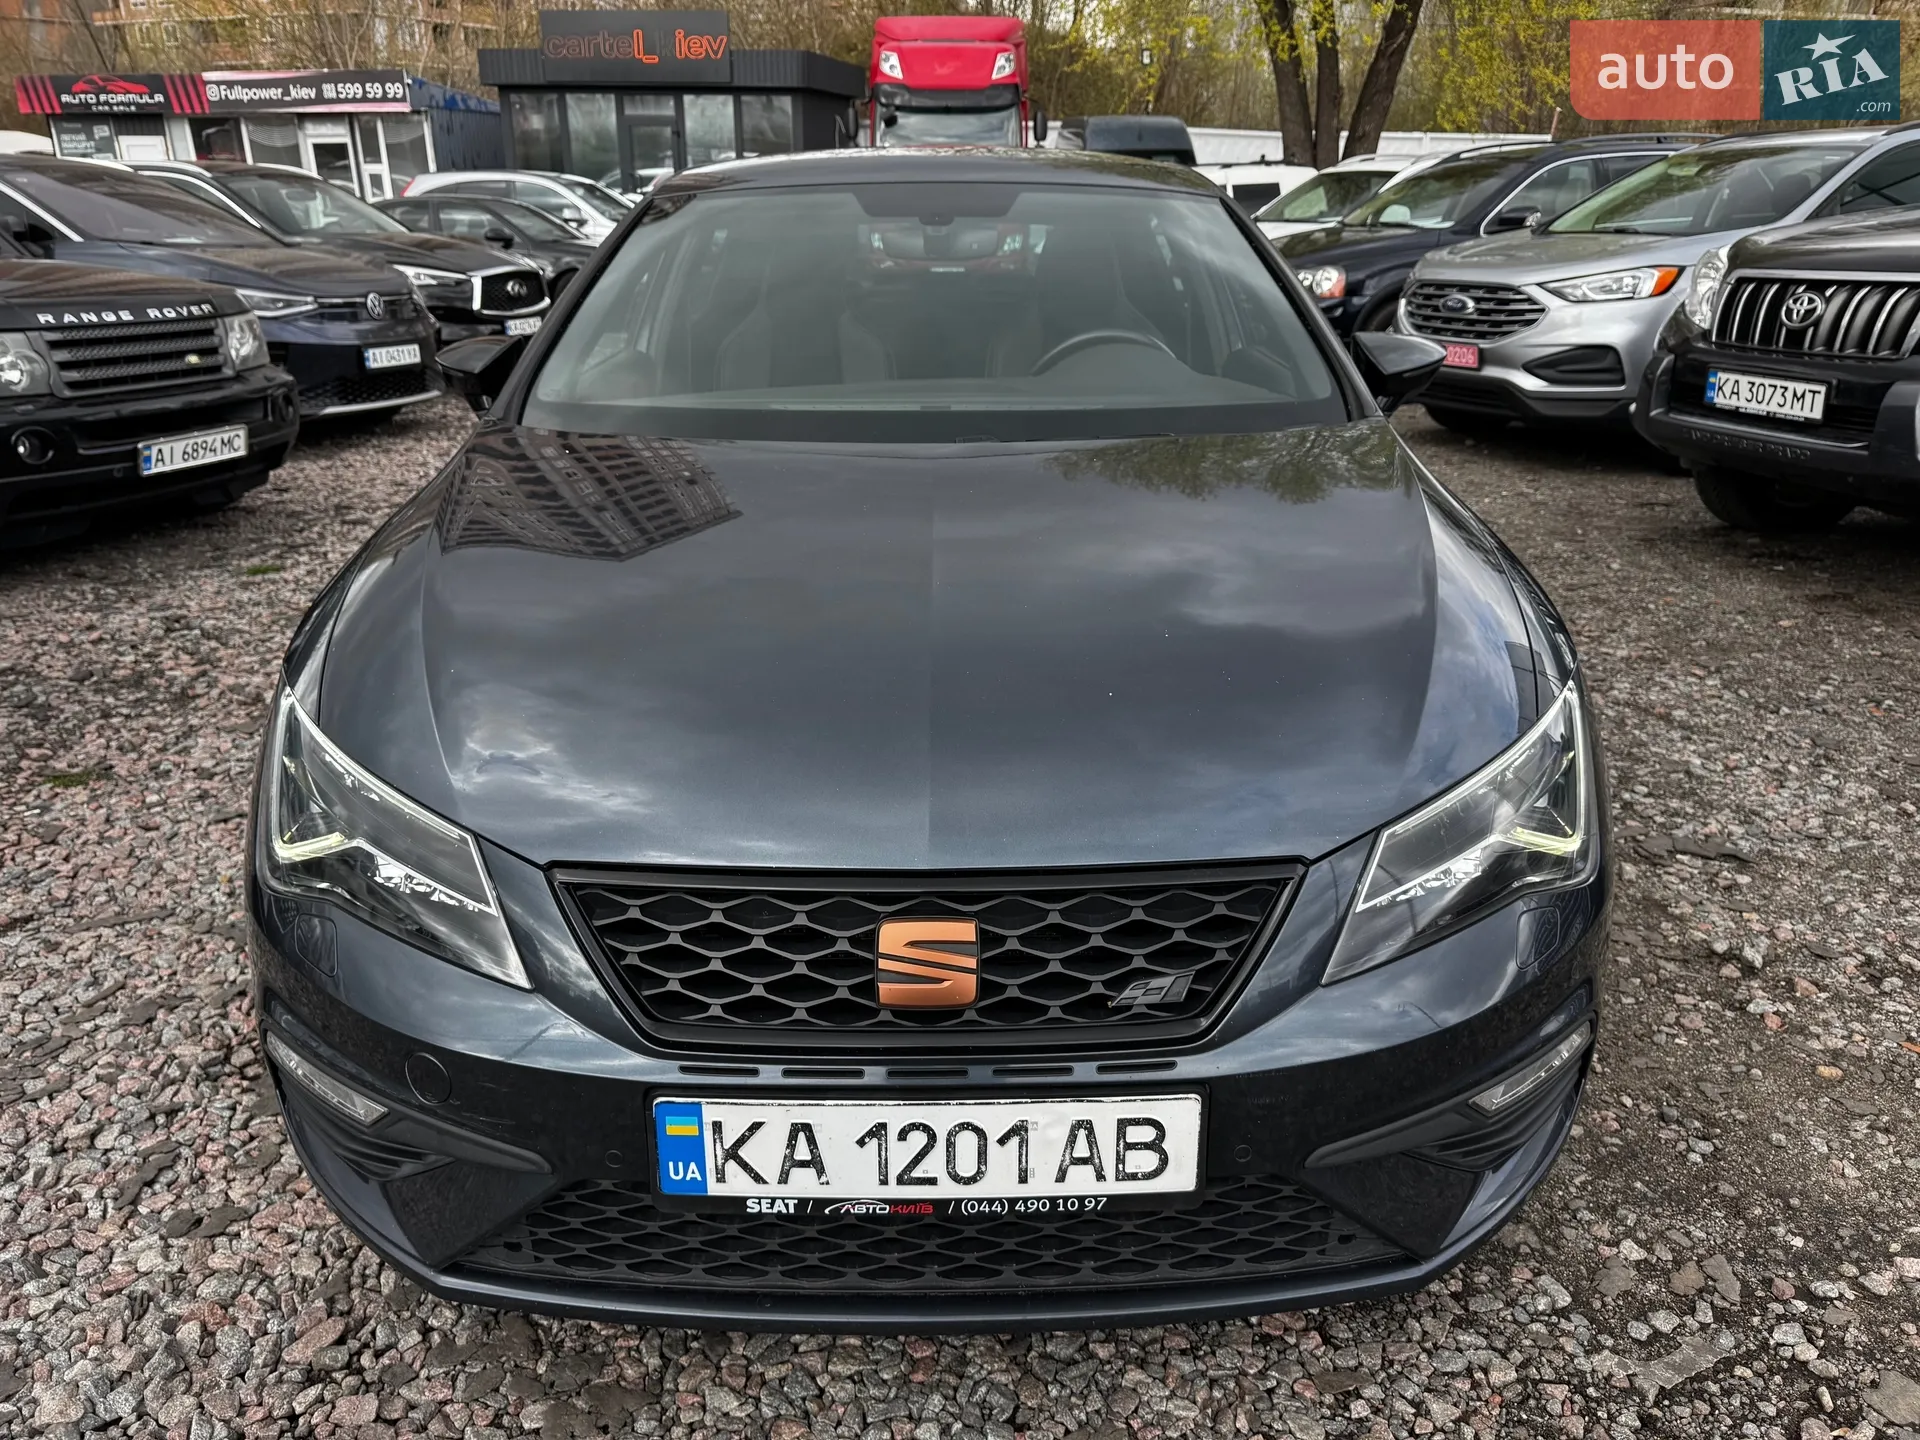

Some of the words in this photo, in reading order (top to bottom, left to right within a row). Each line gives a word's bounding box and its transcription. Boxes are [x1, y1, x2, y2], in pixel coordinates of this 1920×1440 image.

[60, 93, 97, 104] AUTO
[99, 93, 165, 104] FORMULA
[205, 84, 316, 104] @Fullpower_kiev
[337, 82, 363, 99] 599
[365, 82, 383, 99] 59
[385, 82, 404, 99] 99
[36, 310, 135, 325] RANGE
[145, 303, 215, 320] ROVER
[1716, 377, 1741, 402] KA
[1744, 380, 1789, 408] 3073
[1790, 386, 1822, 413] MT
[154, 445, 174, 467] AI
[181, 436, 217, 462] 6894
[220, 433, 241, 455] MC
[711, 1119, 831, 1185] KA
[855, 1119, 1029, 1186] 1201
[1053, 1116, 1169, 1183] AB
[668, 1161, 703, 1181] UA
[746, 1198, 798, 1214] SEAT
[961, 1199, 1008, 1216] (044)
[1014, 1199, 1050, 1213] 490
[1056, 1198, 1079, 1212] 10
[1084, 1197, 1108, 1212] 97
